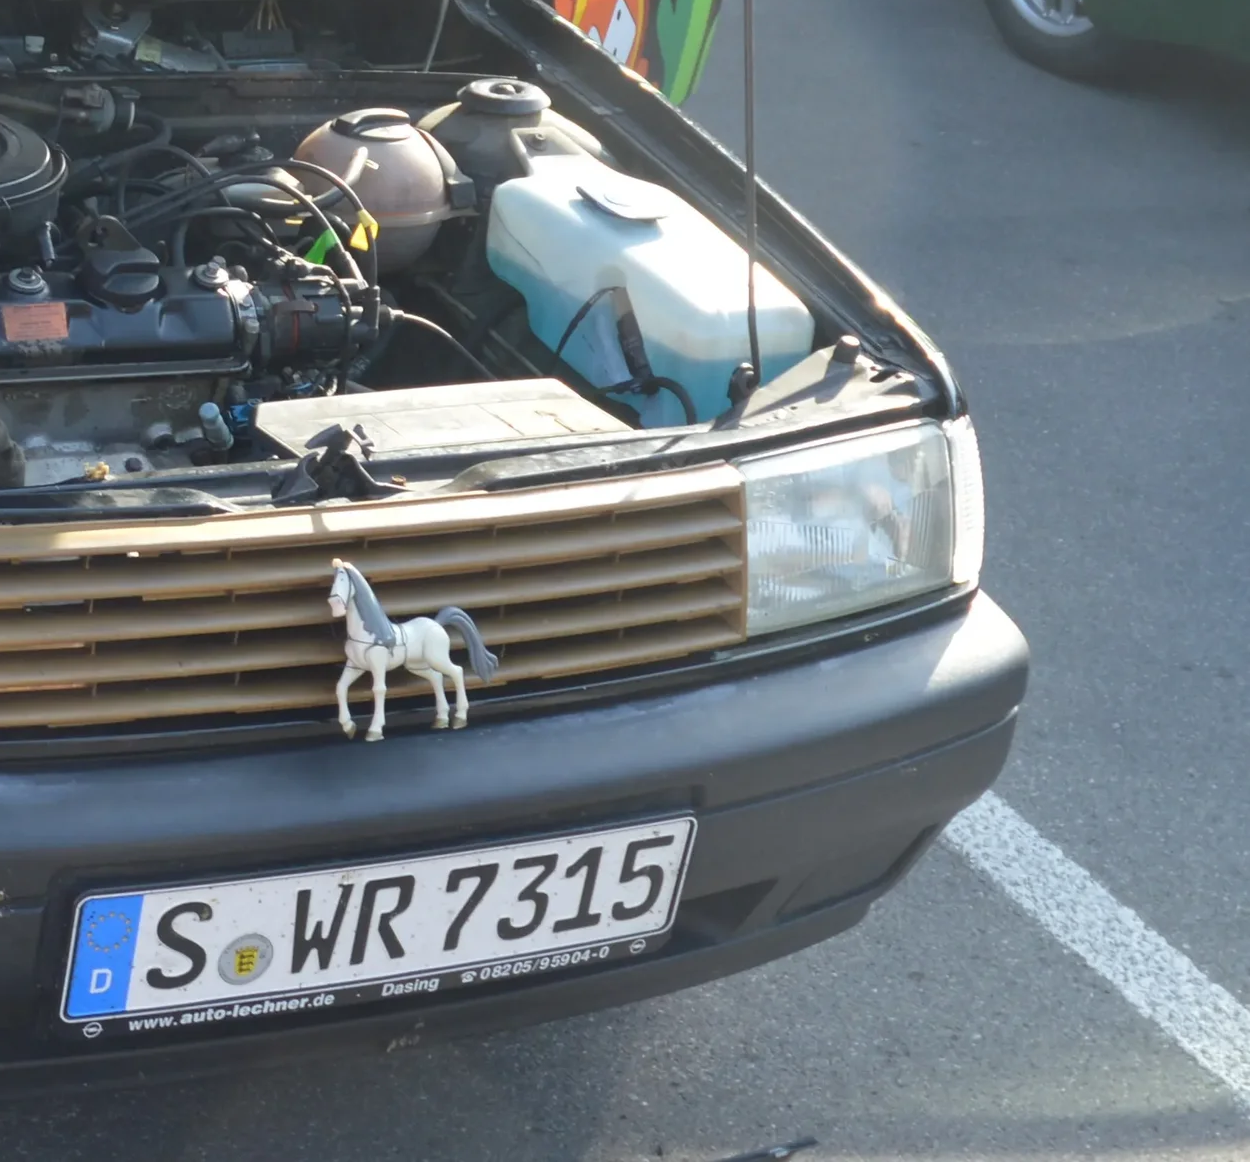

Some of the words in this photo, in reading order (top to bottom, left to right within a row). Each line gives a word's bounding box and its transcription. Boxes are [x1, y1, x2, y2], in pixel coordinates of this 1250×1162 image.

[146, 901, 213, 989] S
[291, 874, 415, 974] WR
[443, 834, 675, 951] 7315
[479, 945, 610, 981] 08205/95904-0
[89, 968, 113, 994] D
[381, 977, 440, 998] Dasing
